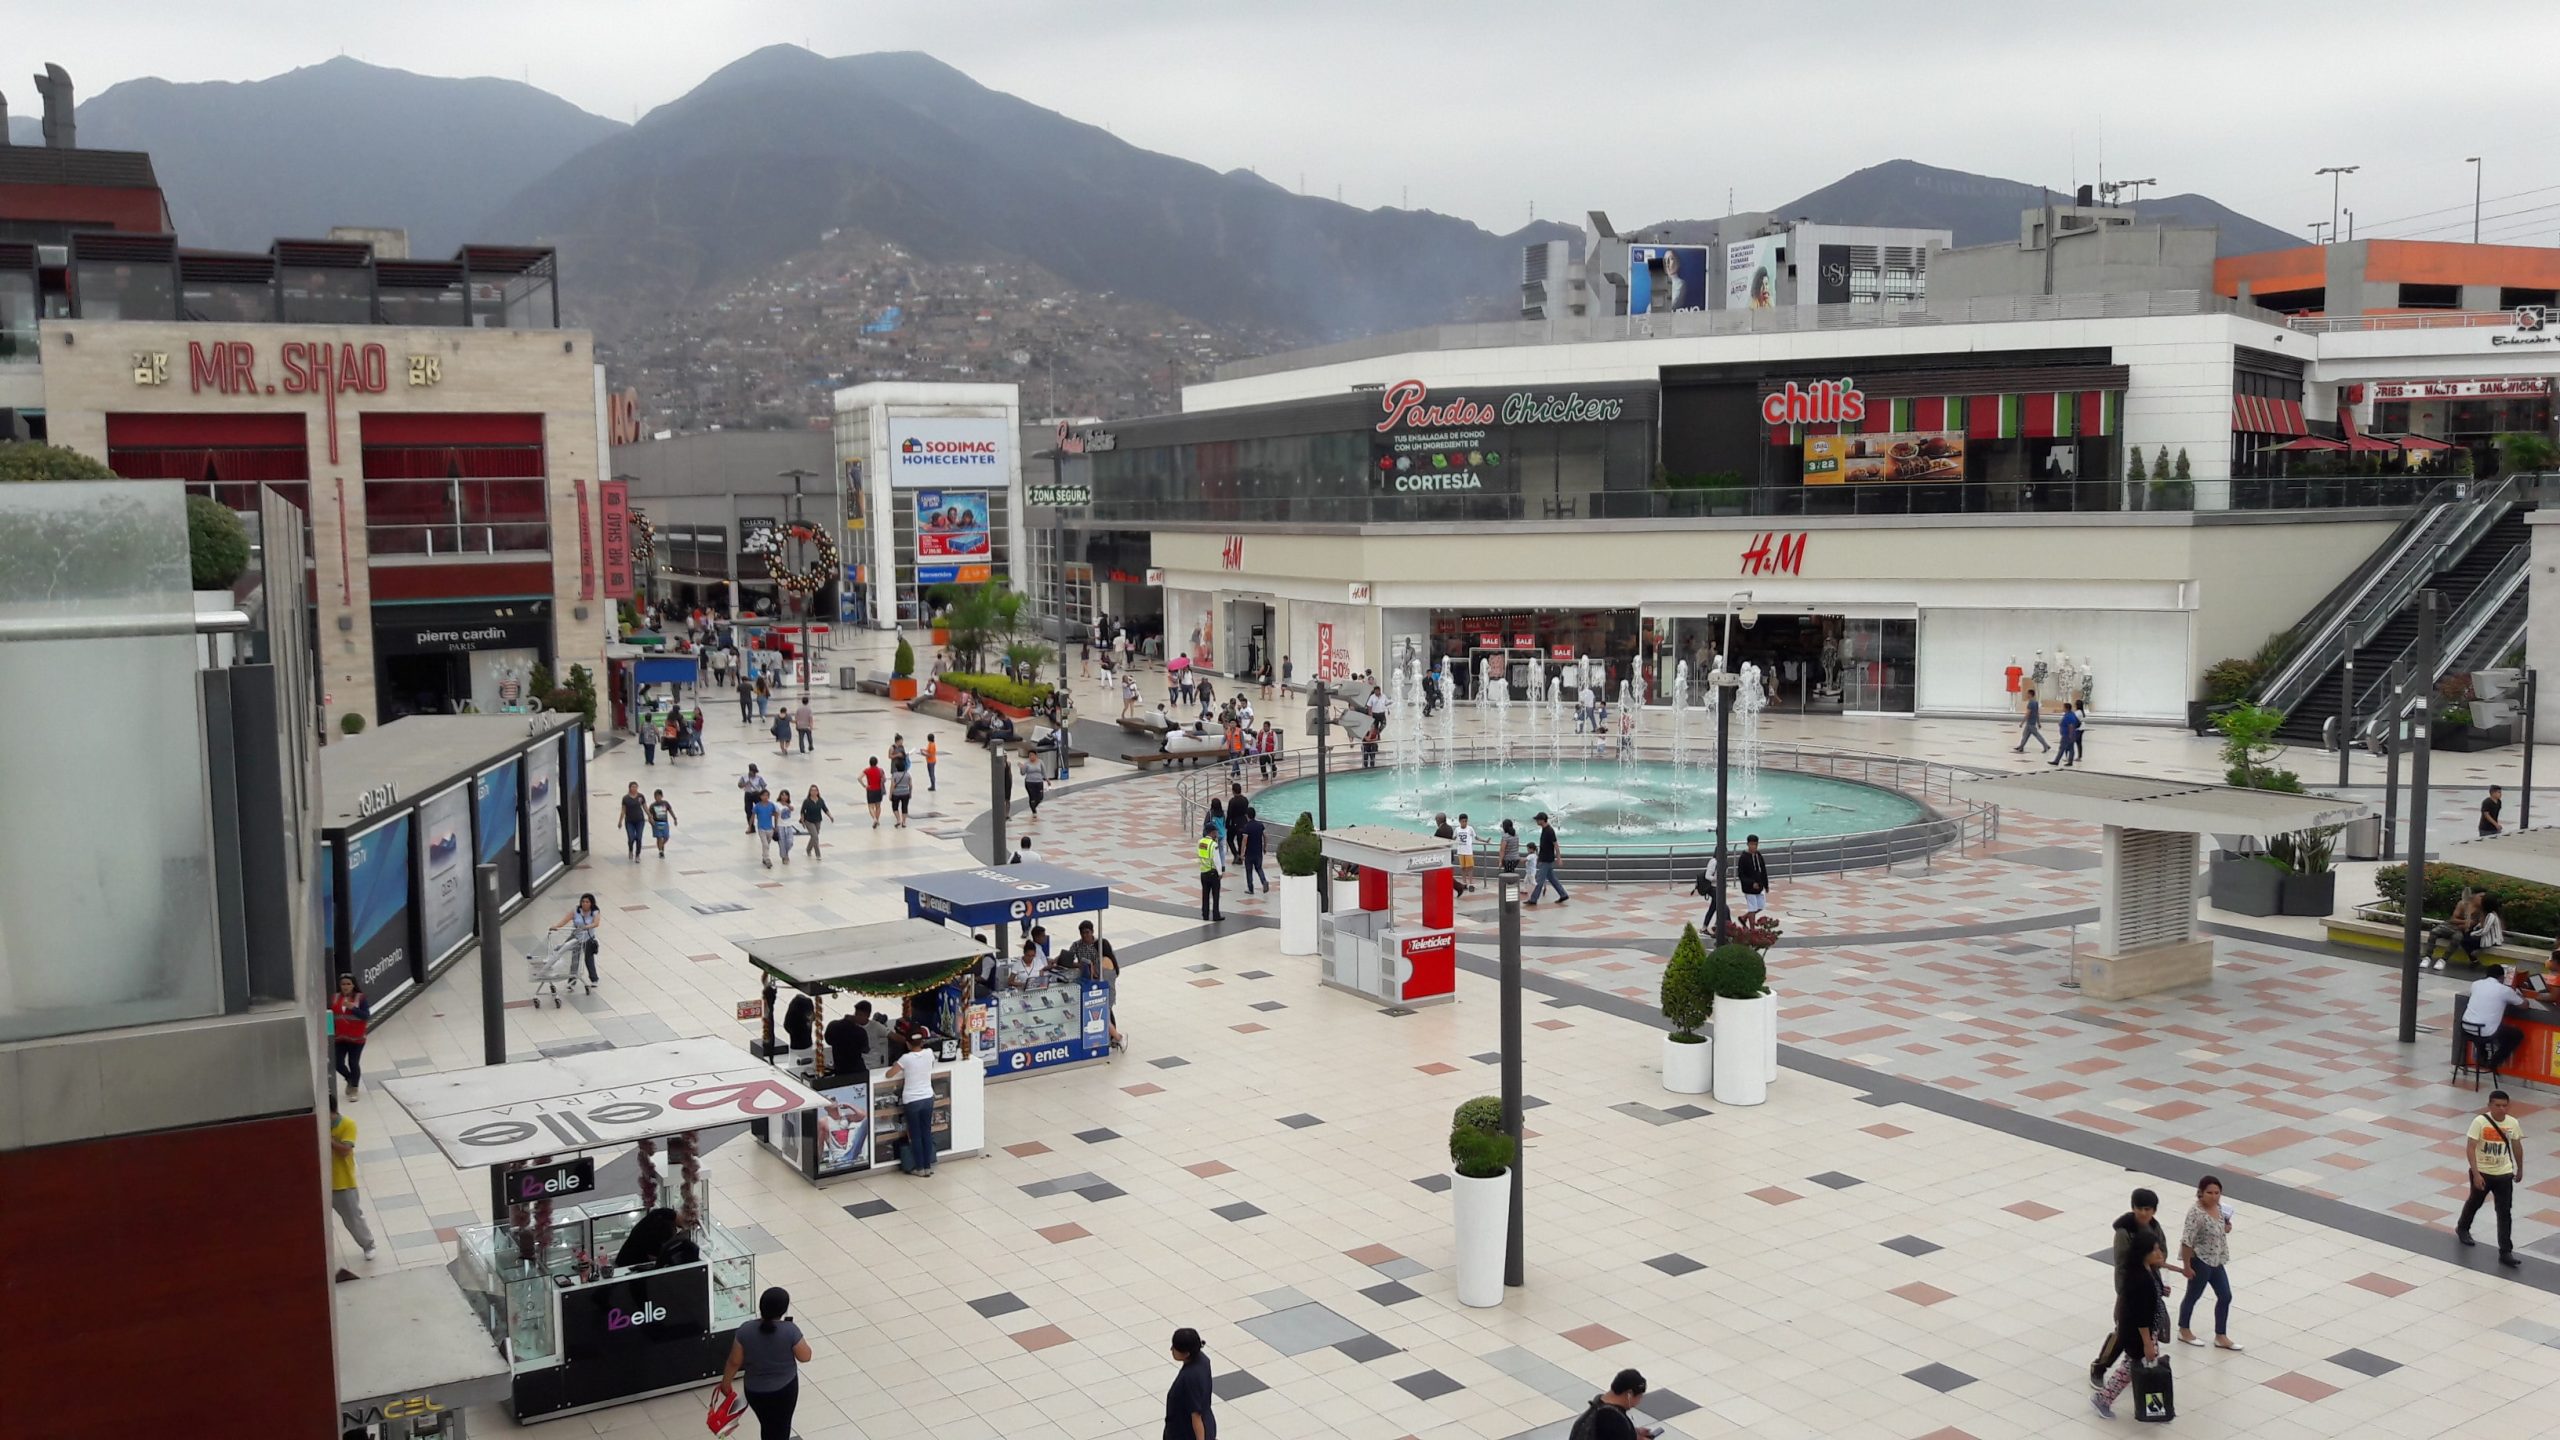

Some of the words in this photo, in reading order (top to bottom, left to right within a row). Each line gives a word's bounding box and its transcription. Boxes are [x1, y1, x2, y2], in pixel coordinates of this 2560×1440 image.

[2374, 386, 2404, 397] FRIES
[1376, 379, 1495, 432] Pardos
[1502, 392, 1622, 425] Chicken
[1762, 377, 1865, 424] chili's
[1394, 435, 1408, 443] TUS
[1408, 432, 1449, 442] ENSALADAS
[1460, 430, 1485, 438] FONDO
[926, 441, 996, 453] SODIMAC
[1394, 443, 1411, 452] CON
[1411, 442, 1422, 450] UN
[1422, 440, 1469, 449] INGREDIENTE
[1469, 439, 1479, 447] DE
[902, 455, 995, 465] HOMECENTER
[1395, 468, 1481, 491] CORTESÍA
[1033, 490, 1054, 501] ZONA
[1056, 489, 1087, 501] SEGURA
[1222, 535, 1243, 571] H&M
[1740, 532, 1808, 576] H&M
[1352, 586, 1368, 599] H&M
[417, 629, 459, 644] pierre
[462, 627, 506, 641] cardin
[1482, 638, 1499, 646] SALE
[1516, 638, 1533, 646] SALE
[449, 642, 476, 651] PARIS
[1320, 626, 1331, 681] SALE
[1554, 649, 1571, 657] SALE
[1332, 649, 1350, 661] HASTA
[1332, 661, 1351, 679] 50%
[1411, 854, 1445, 865] Teleticket
[1036, 895, 1074, 914] entel
[1411, 935, 1452, 950] Teleticket
[1035, 1045, 1070, 1064] entel
[458, 1079, 805, 1147] Belle
[521, 1166, 580, 1198] Belle
[607, 1300, 668, 1331] Belle
